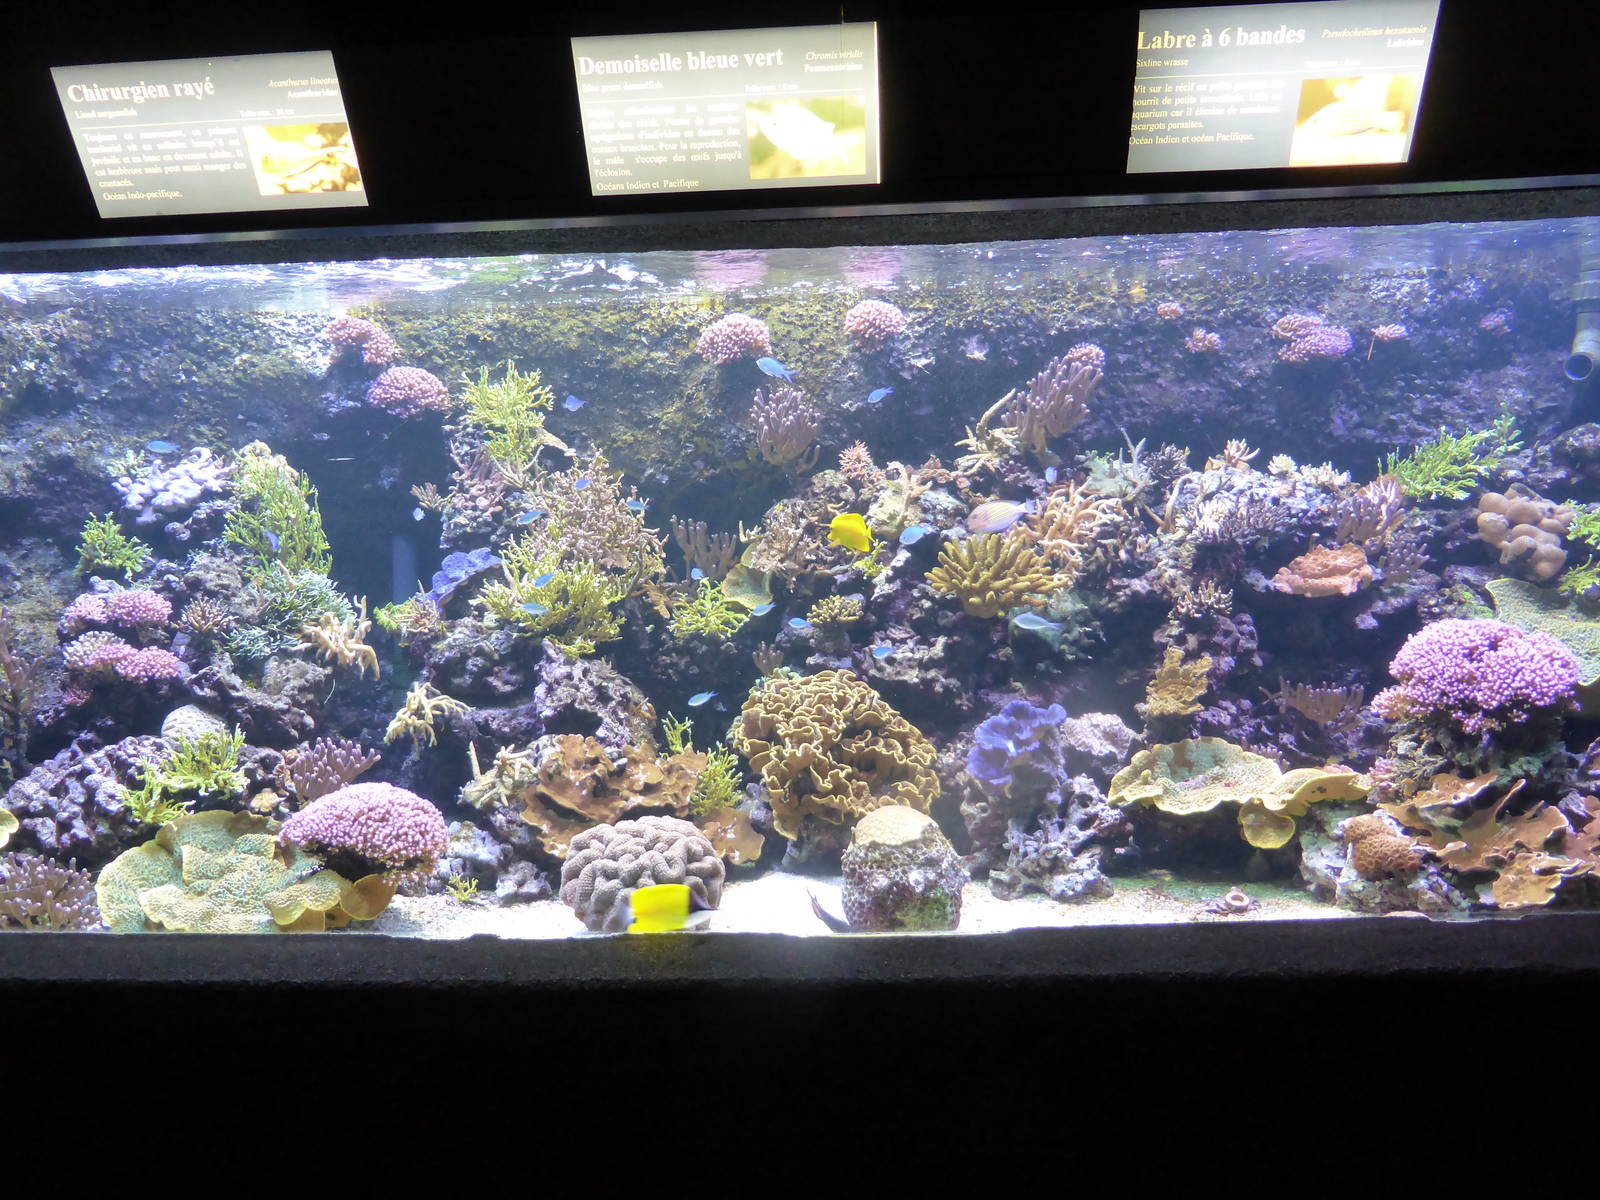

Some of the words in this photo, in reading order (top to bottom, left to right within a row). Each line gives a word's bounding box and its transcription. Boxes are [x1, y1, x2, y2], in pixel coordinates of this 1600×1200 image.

[1137, 30, 1196, 50] Labre
[1201, 28, 1213, 48] à
[1218, 27, 1232, 47] 6
[1236, 24, 1307, 46] bandes
[577, 52, 682, 76] Demoiselle
[686, 51, 740, 71] bleue
[743, 48, 784, 67] vert
[805, 51, 838, 61] Chromis
[1136, 58, 1163, 69] Sixline
[1163, 58, 1189, 67] wrasse
[67, 80, 171, 104] Chirurgien
[173, 76, 215, 101] rayé
[1149, 85, 1162, 93] sur
[1165, 83, 1173, 93] le
[1162, 95, 1172, 106] de
[1129, 134, 1153, 145] Océan
[1155, 134, 1180, 145] Indien
[1182, 135, 1190, 143] et
[1191, 133, 1215, 143] océan
[626, 179, 651, 190] Indien
[651, 180, 660, 189] et
[663, 178, 699, 190] Pacifique
